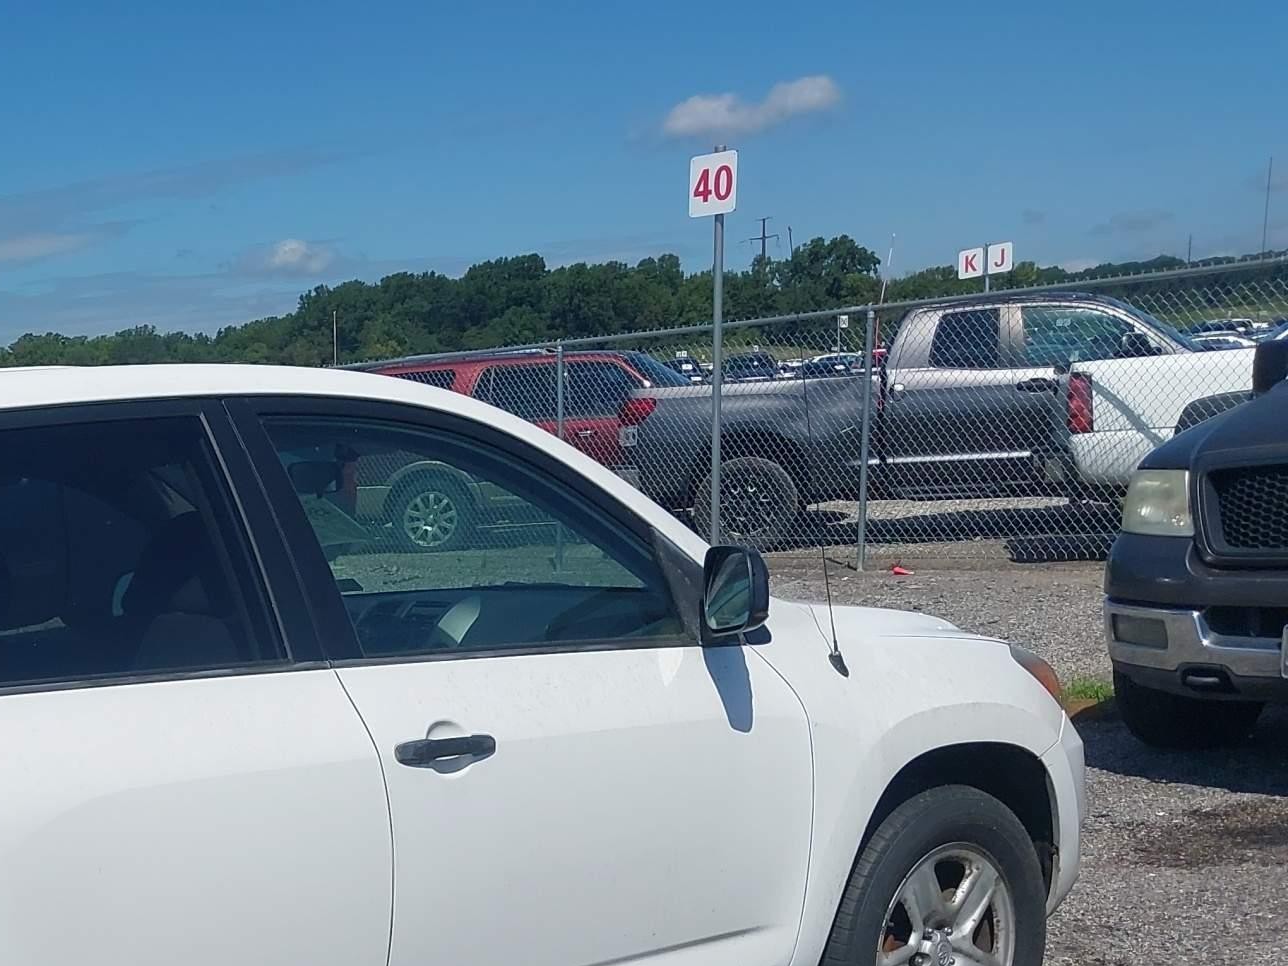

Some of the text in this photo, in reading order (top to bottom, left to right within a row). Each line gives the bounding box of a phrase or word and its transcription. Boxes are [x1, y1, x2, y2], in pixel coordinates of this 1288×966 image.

[693, 164, 733, 203] 40
[964, 253, 977, 273] K
[994, 247, 1005, 267] J
